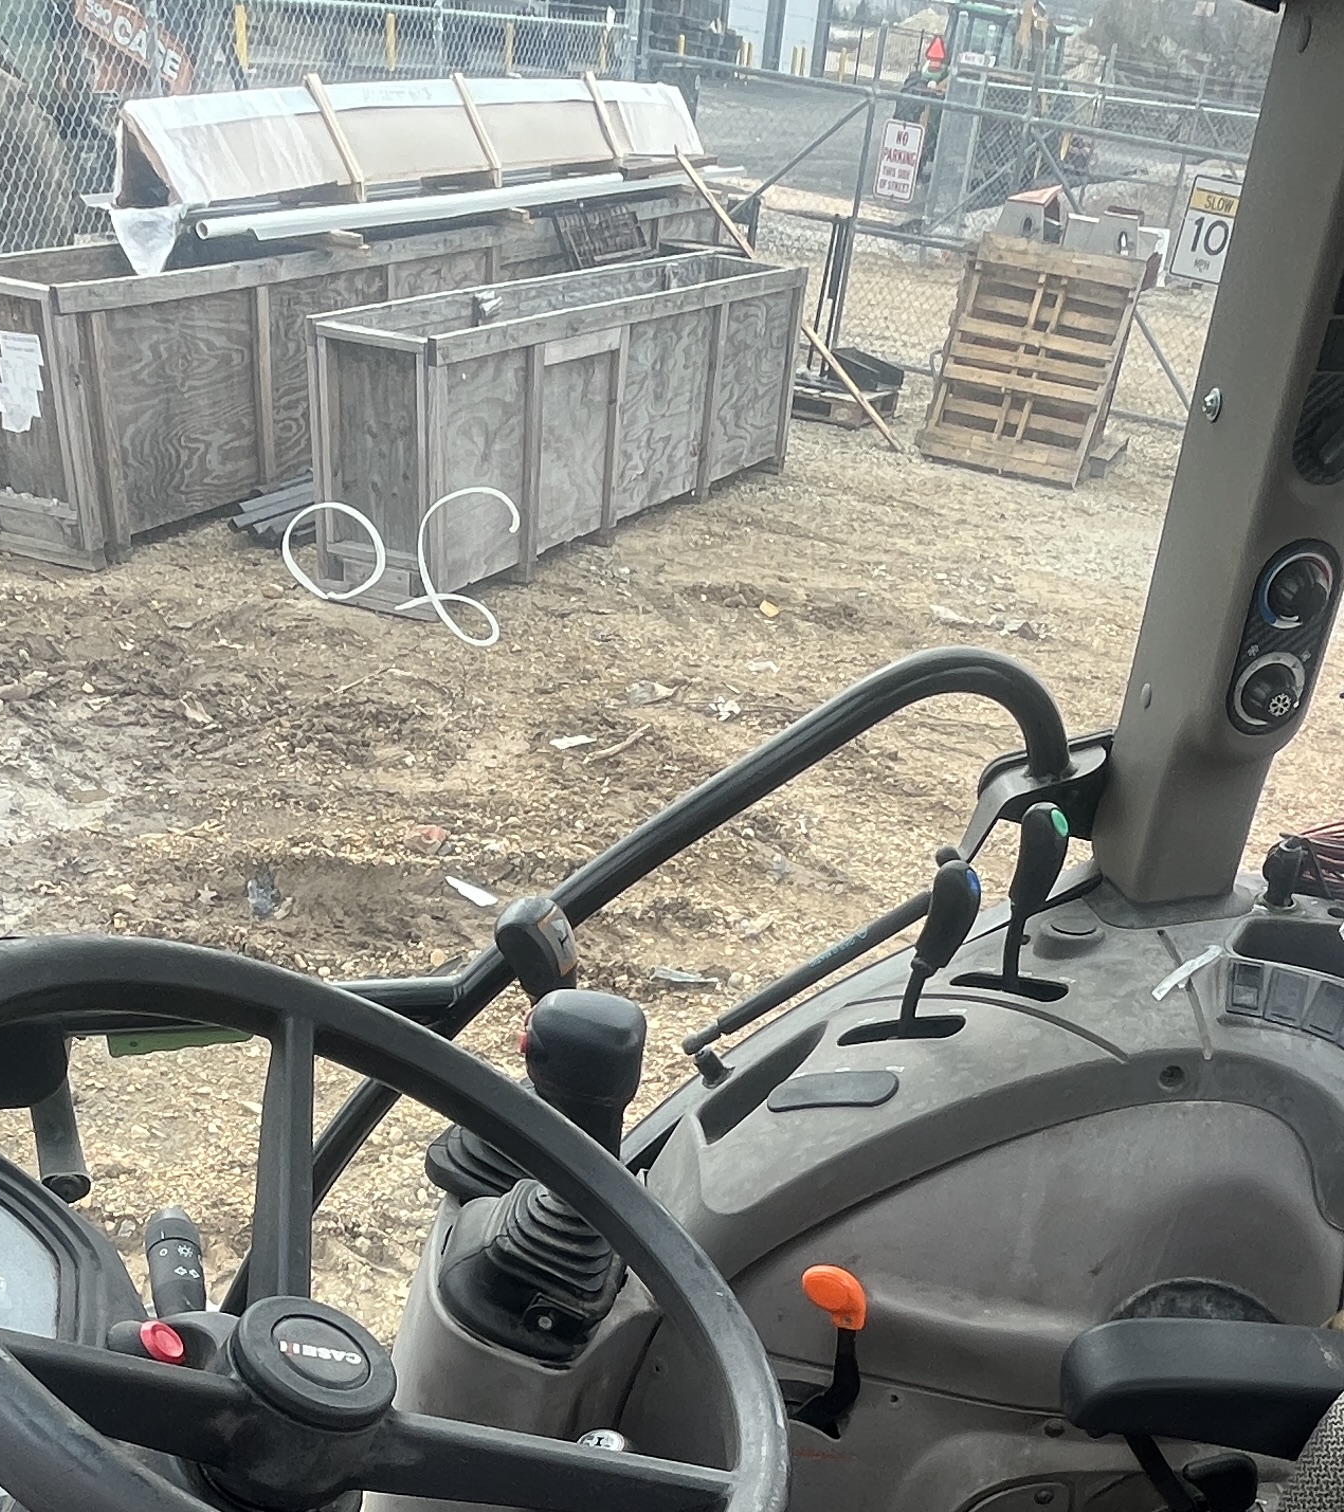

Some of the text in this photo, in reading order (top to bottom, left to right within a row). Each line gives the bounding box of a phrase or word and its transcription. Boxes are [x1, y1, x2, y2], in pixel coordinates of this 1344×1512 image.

[896, 131, 909, 146] NO
[883, 147, 916, 166] PARKING
[1204, 195, 1234, 213] SLOW
[1190, 216, 1229, 256] 10
[302, 1344, 362, 1365] CASE
